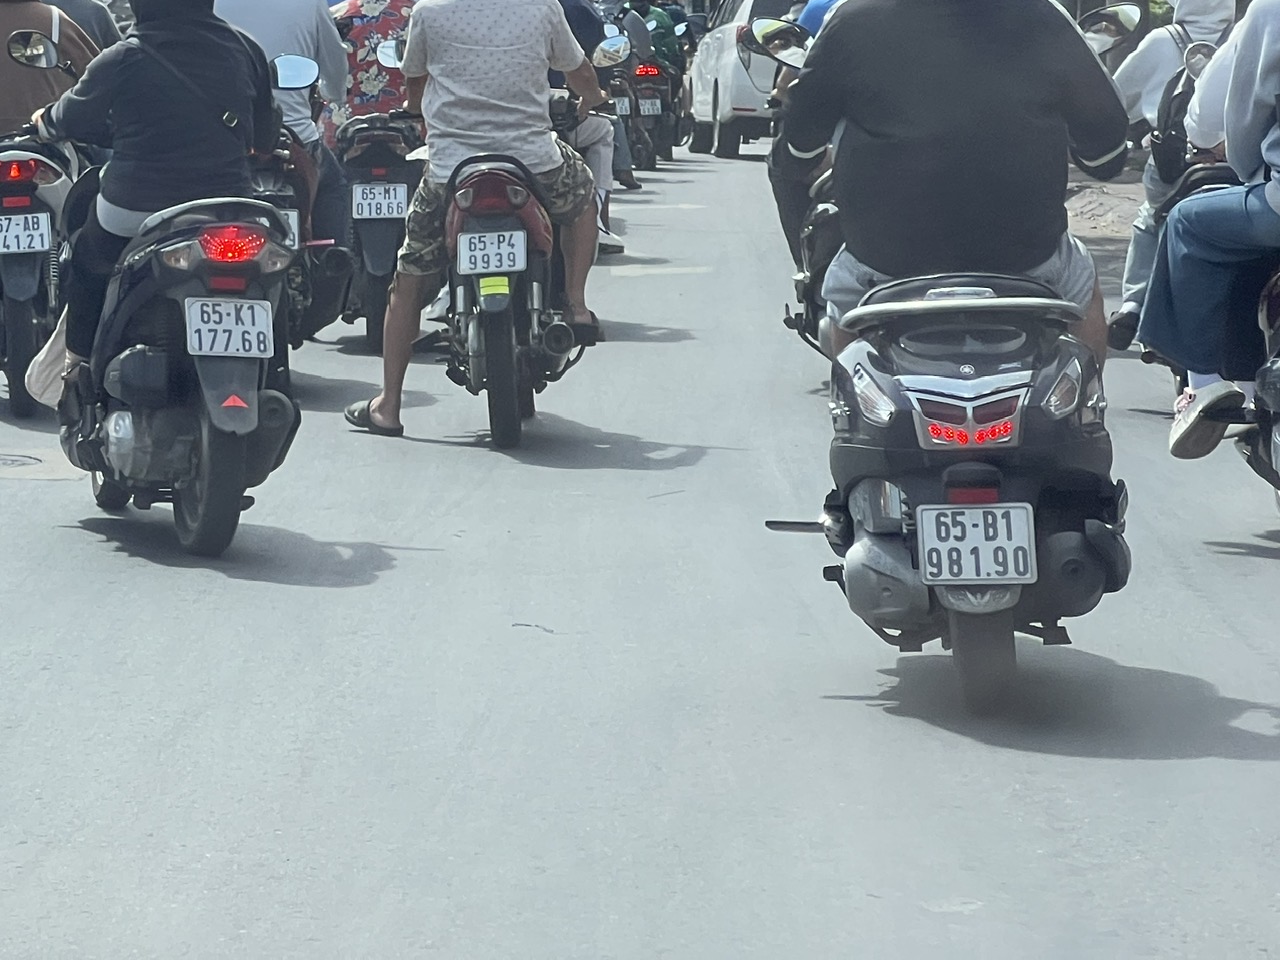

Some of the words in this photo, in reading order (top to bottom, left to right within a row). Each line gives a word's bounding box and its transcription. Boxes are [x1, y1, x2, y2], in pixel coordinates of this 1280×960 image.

[361, 187, 397, 201] 65-M1
[356, 202, 404, 217] 018.66
[468, 233, 516, 252] 65-P4
[468, 252, 517, 271] 9939
[194, 328, 268, 353] 177.68
[935, 510, 1013, 542] 65-B1
[927, 546, 1029, 578] 981.90
